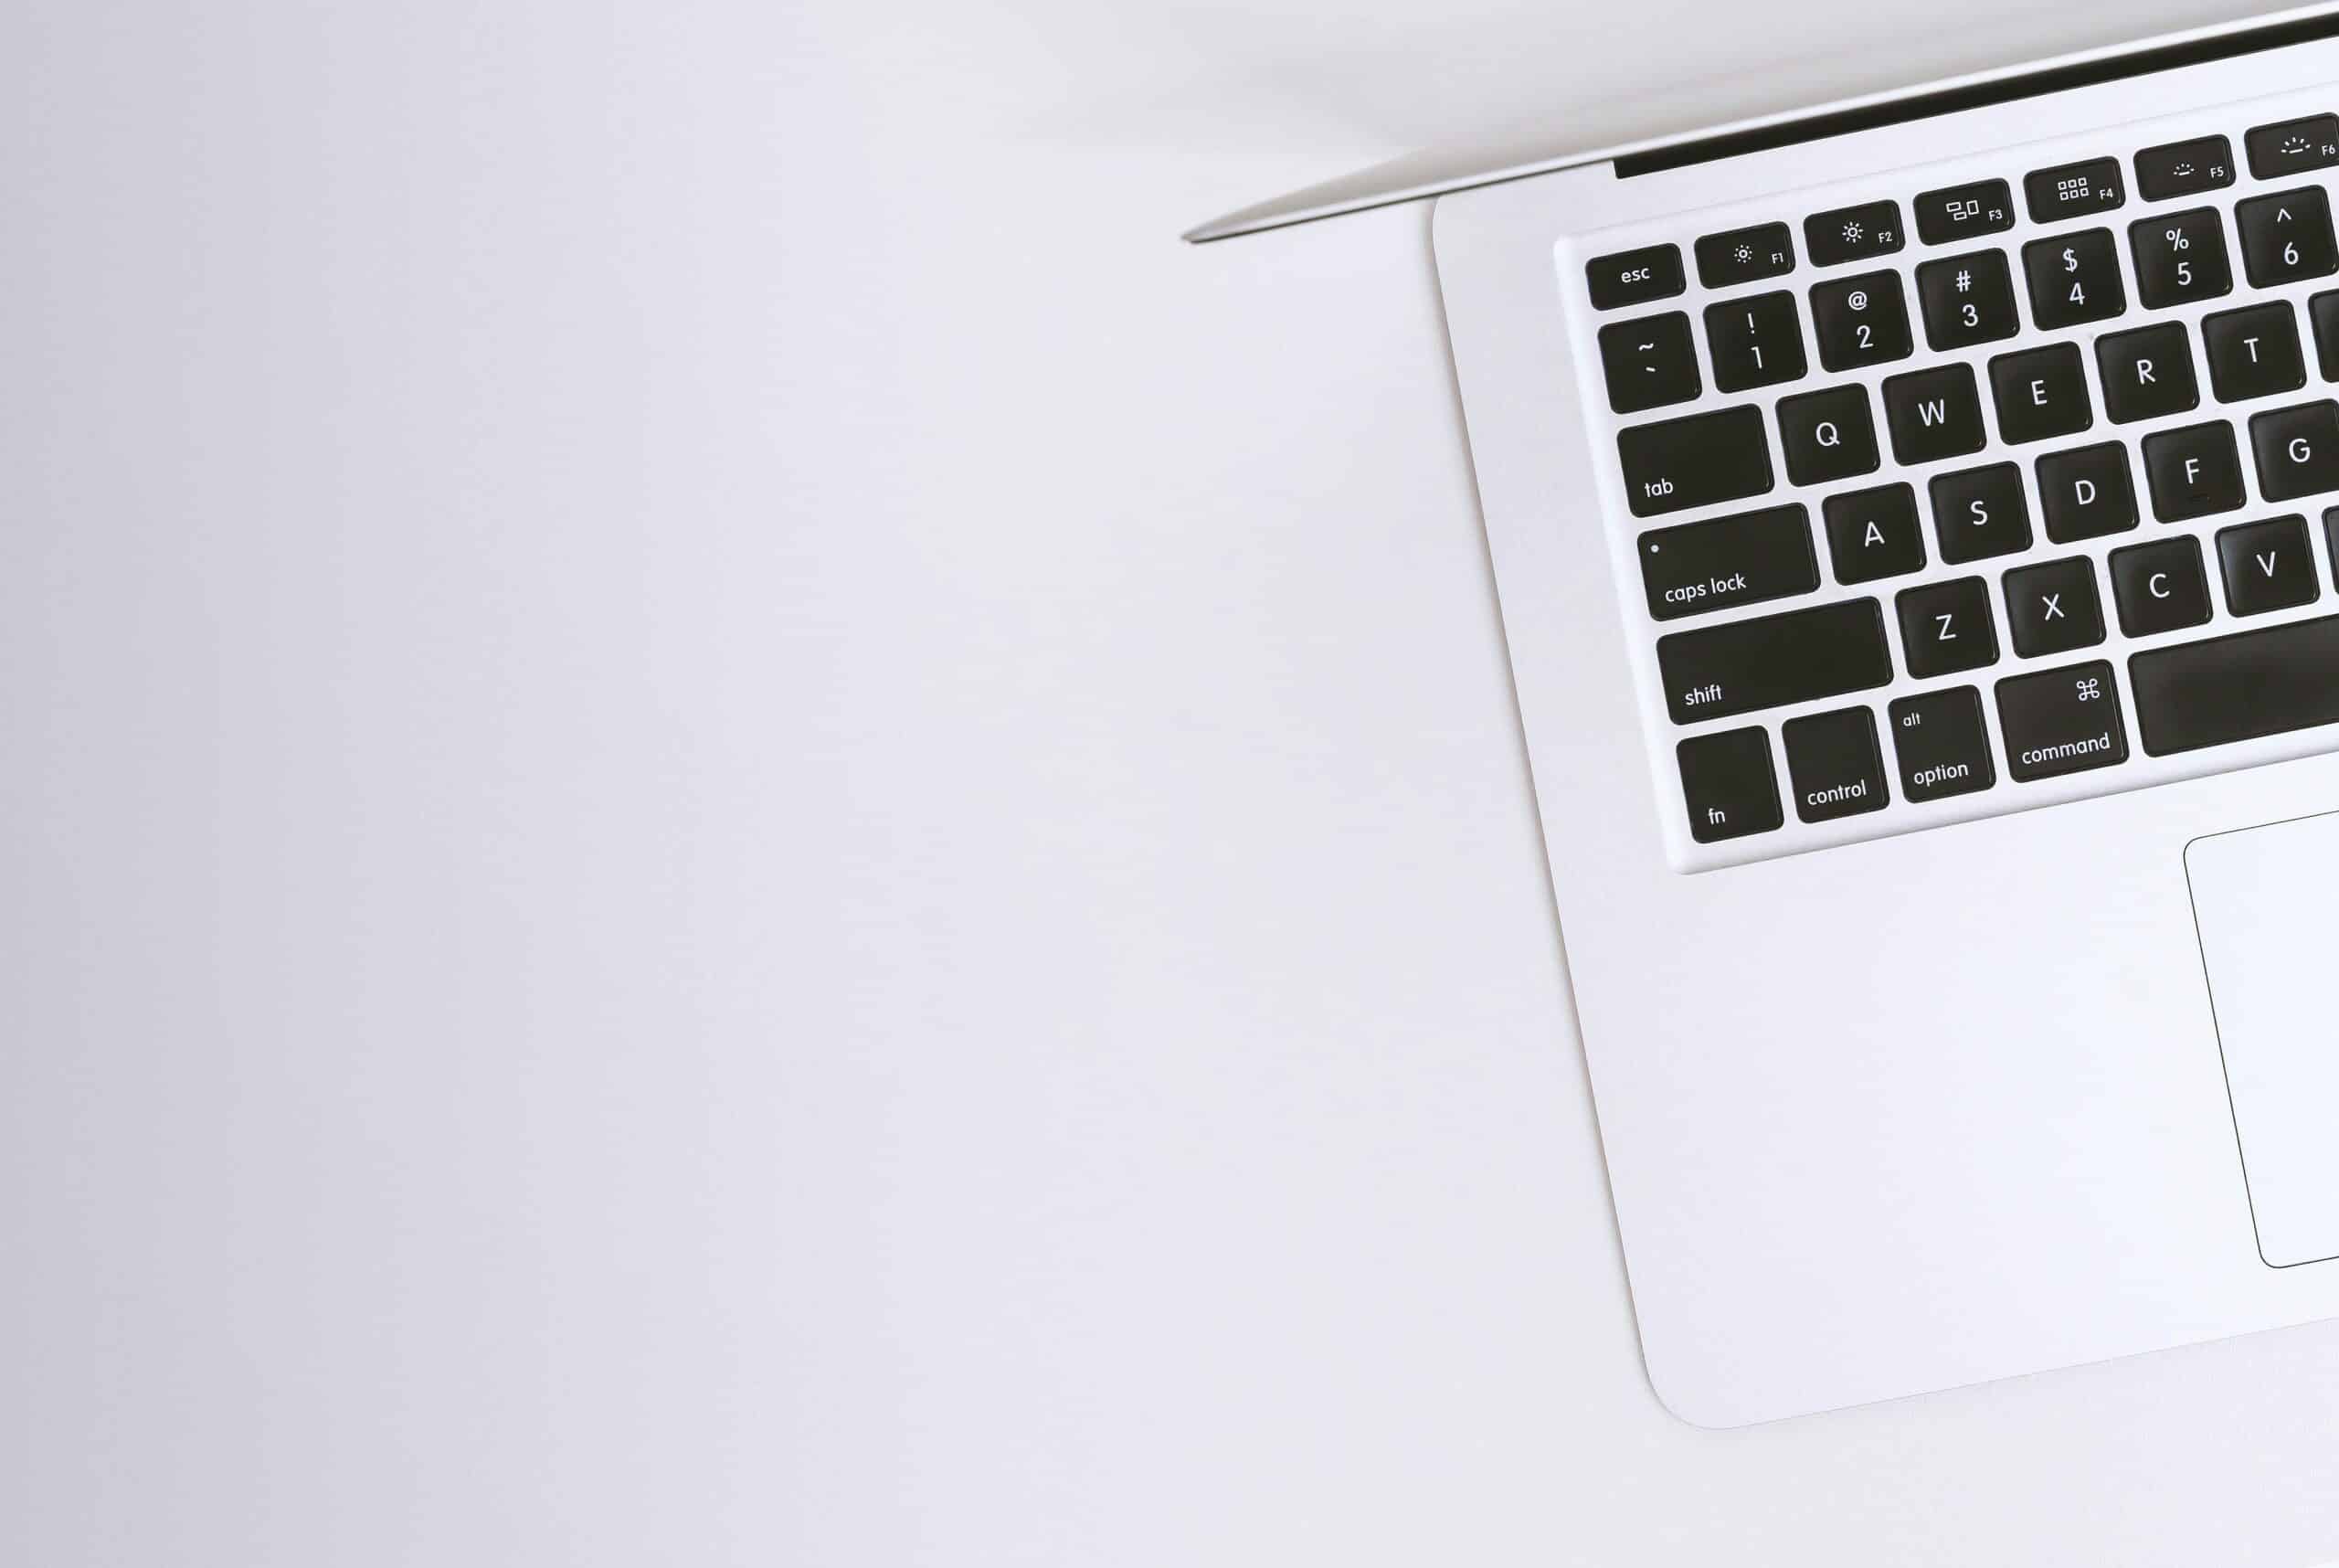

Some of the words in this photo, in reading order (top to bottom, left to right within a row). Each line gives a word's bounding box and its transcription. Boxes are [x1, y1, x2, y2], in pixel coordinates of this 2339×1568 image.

[2321, 143, 2336, 157] F6
[2209, 165, 2225, 179] F5
[2099, 187, 2114, 200] F4
[1988, 208, 2003, 222] F3
[2276, 207, 2292, 223] ^
[1878, 230, 1893, 244] F2
[2165, 227, 2190, 252] %
[1771, 252, 1784, 264] F1
[2062, 247, 2079, 273] $
[2283, 241, 2299, 266] 6
[1621, 268, 1650, 282] esc
[1955, 270, 1972, 293] #
[2177, 261, 2192, 286] 5
[1847, 291, 1868, 311] @
[2069, 281, 2086, 305] 4
[1747, 313, 1755, 334] !
[1962, 303, 1979, 327] 3
[1856, 324, 1874, 349] 2
[1751, 345, 1762, 369] 1
[2243, 337, 2260, 363] T
[2136, 358, 2156, 386] R
[2030, 379, 2048, 406] E
[1918, 398, 1945, 427] W
[1815, 421, 1841, 447] Q
[2288, 438, 2311, 463] G
[2185, 458, 2200, 484] F
[1645, 478, 1673, 497] tab
[2074, 479, 2096, 505] D
[1970, 500, 1988, 526] S
[1864, 521, 1886, 547] A
[2256, 550, 2276, 577] V
[1666, 585, 1706, 602] caps
[1710, 573, 1746, 594] lock
[2149, 573, 2171, 599] C
[2041, 593, 2065, 621] X
[1935, 613, 1957, 641] Z
[1685, 684, 1721, 705] shift
[1903, 713, 1921, 726] alt
[2022, 733, 2110, 765] command
[1914, 765, 1968, 786] option
[1808, 779, 1867, 805] control
[1709, 808, 1725, 824] fn
